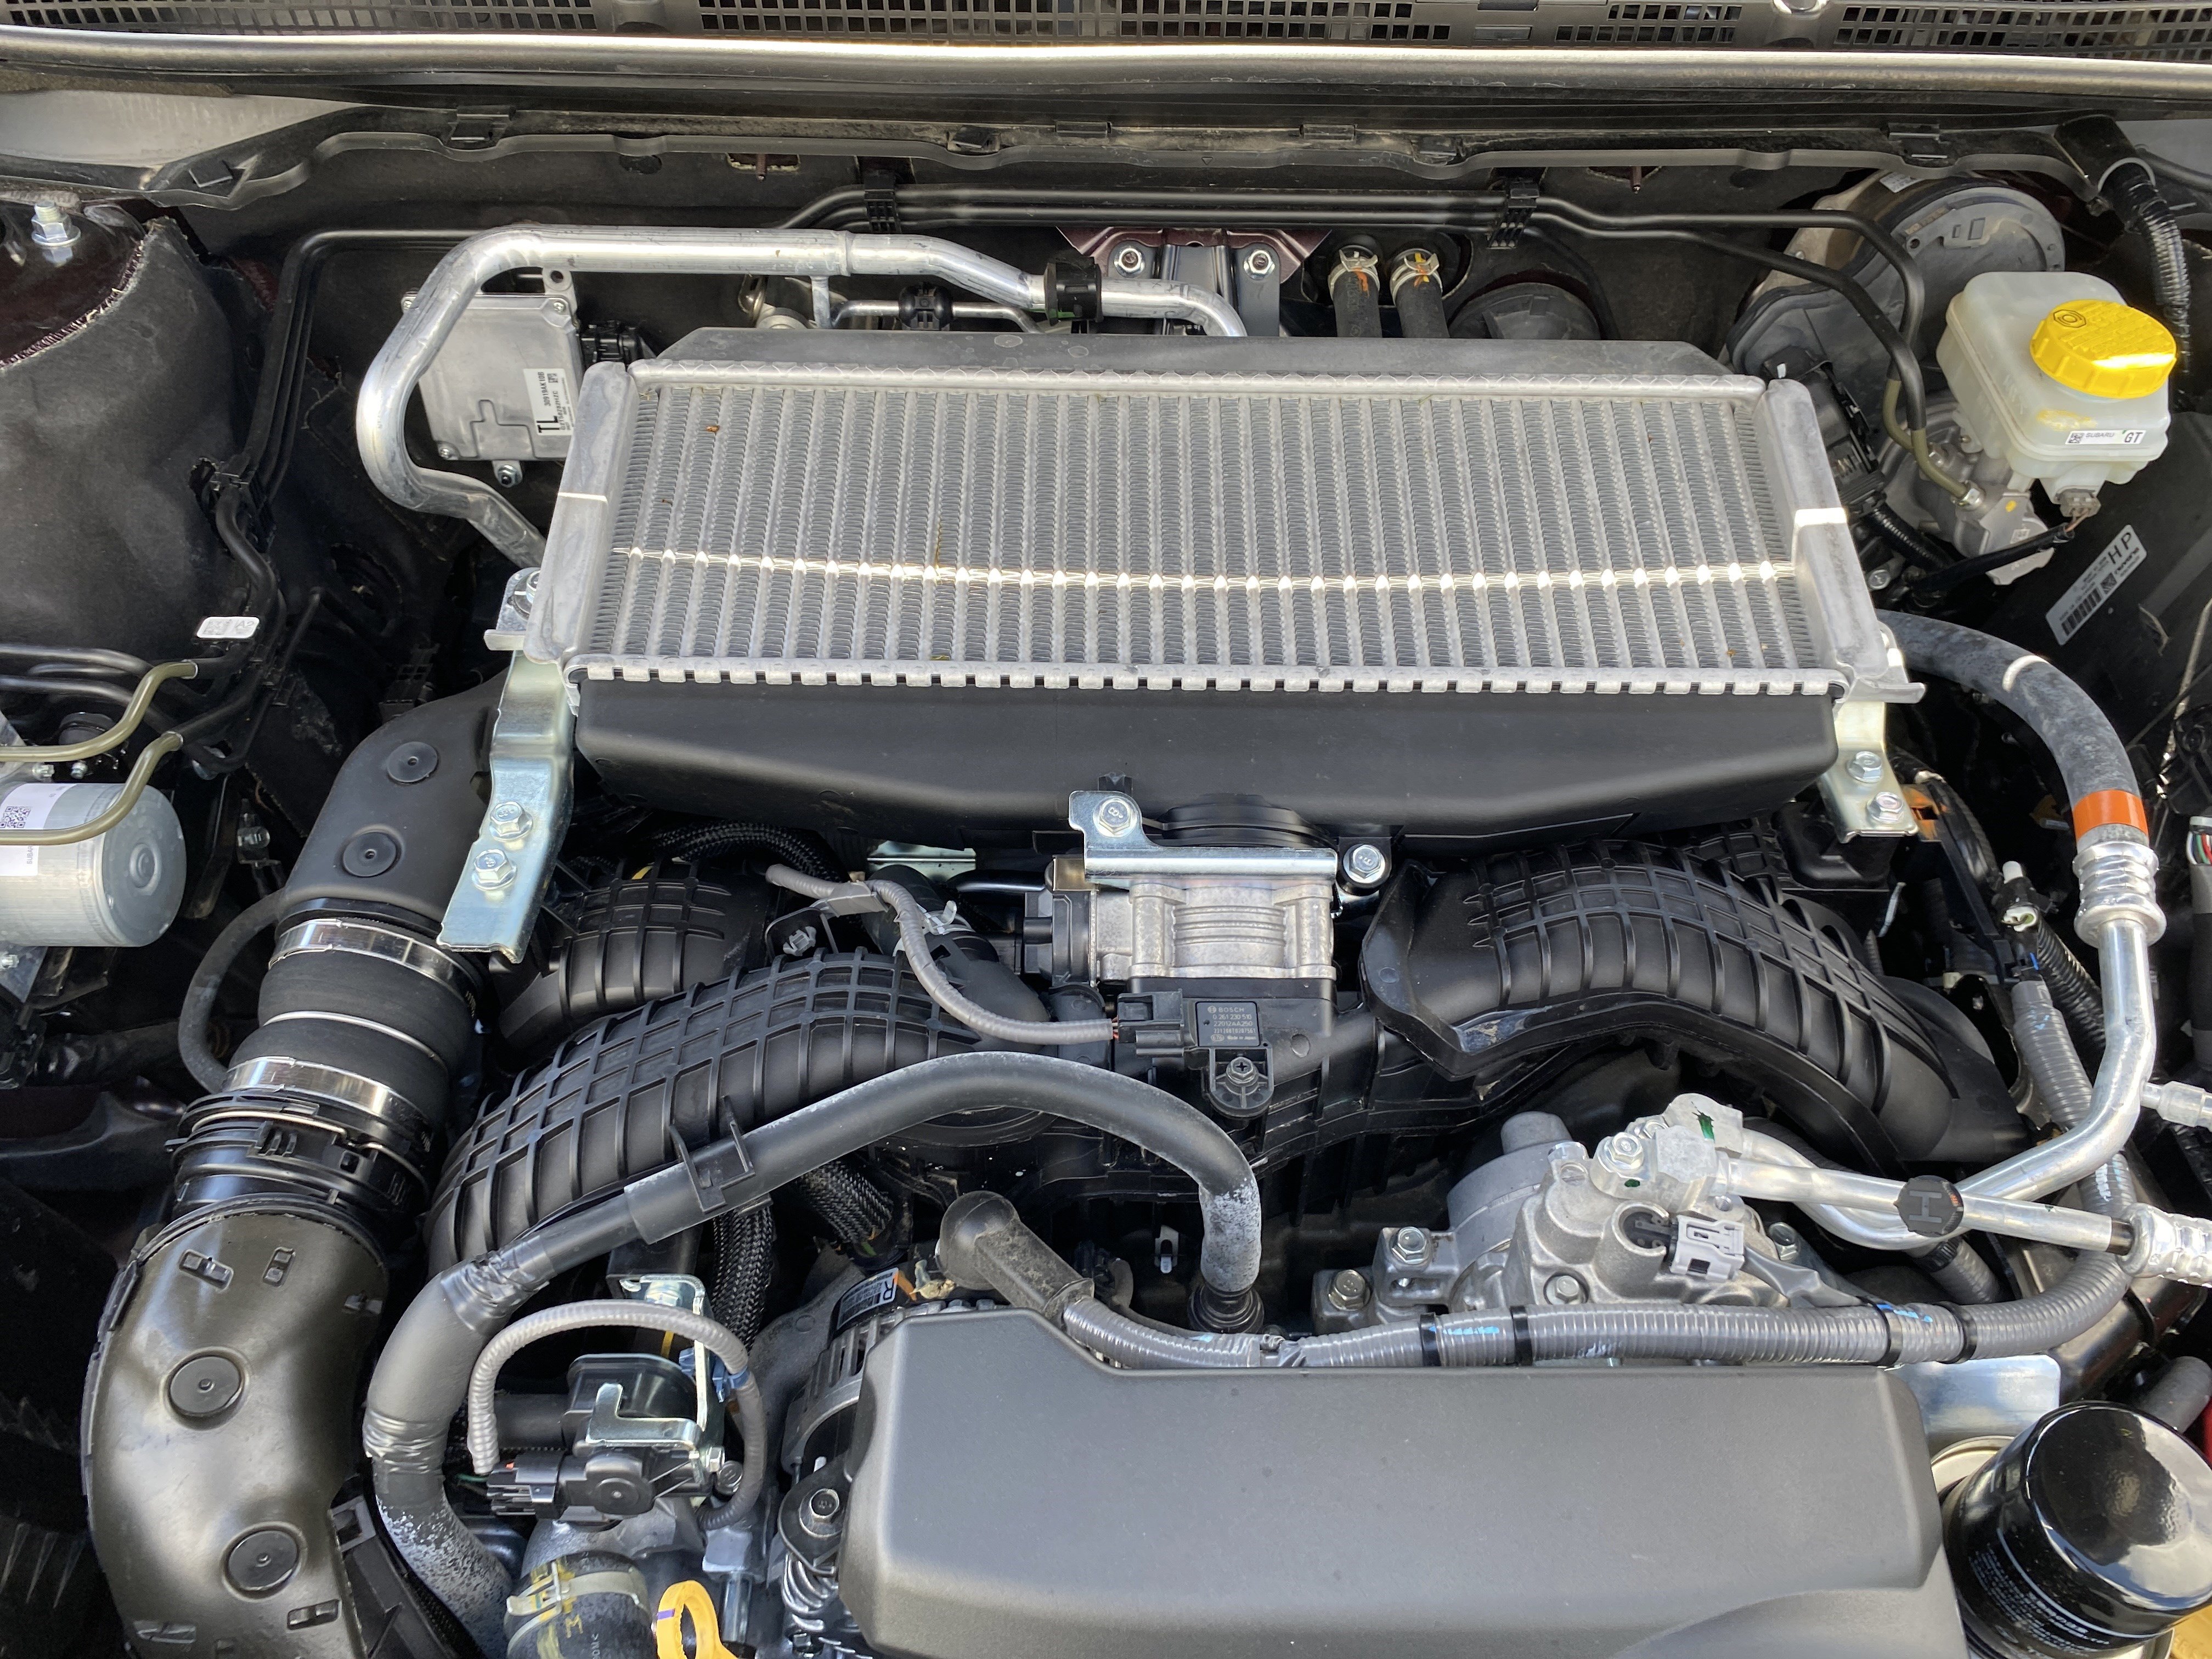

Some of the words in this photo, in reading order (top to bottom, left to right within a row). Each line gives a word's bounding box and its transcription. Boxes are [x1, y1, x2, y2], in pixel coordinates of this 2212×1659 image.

[537, 416, 559, 433] TL
[2124, 432, 2143, 443] GT
[883, 1278, 895, 1300] R
